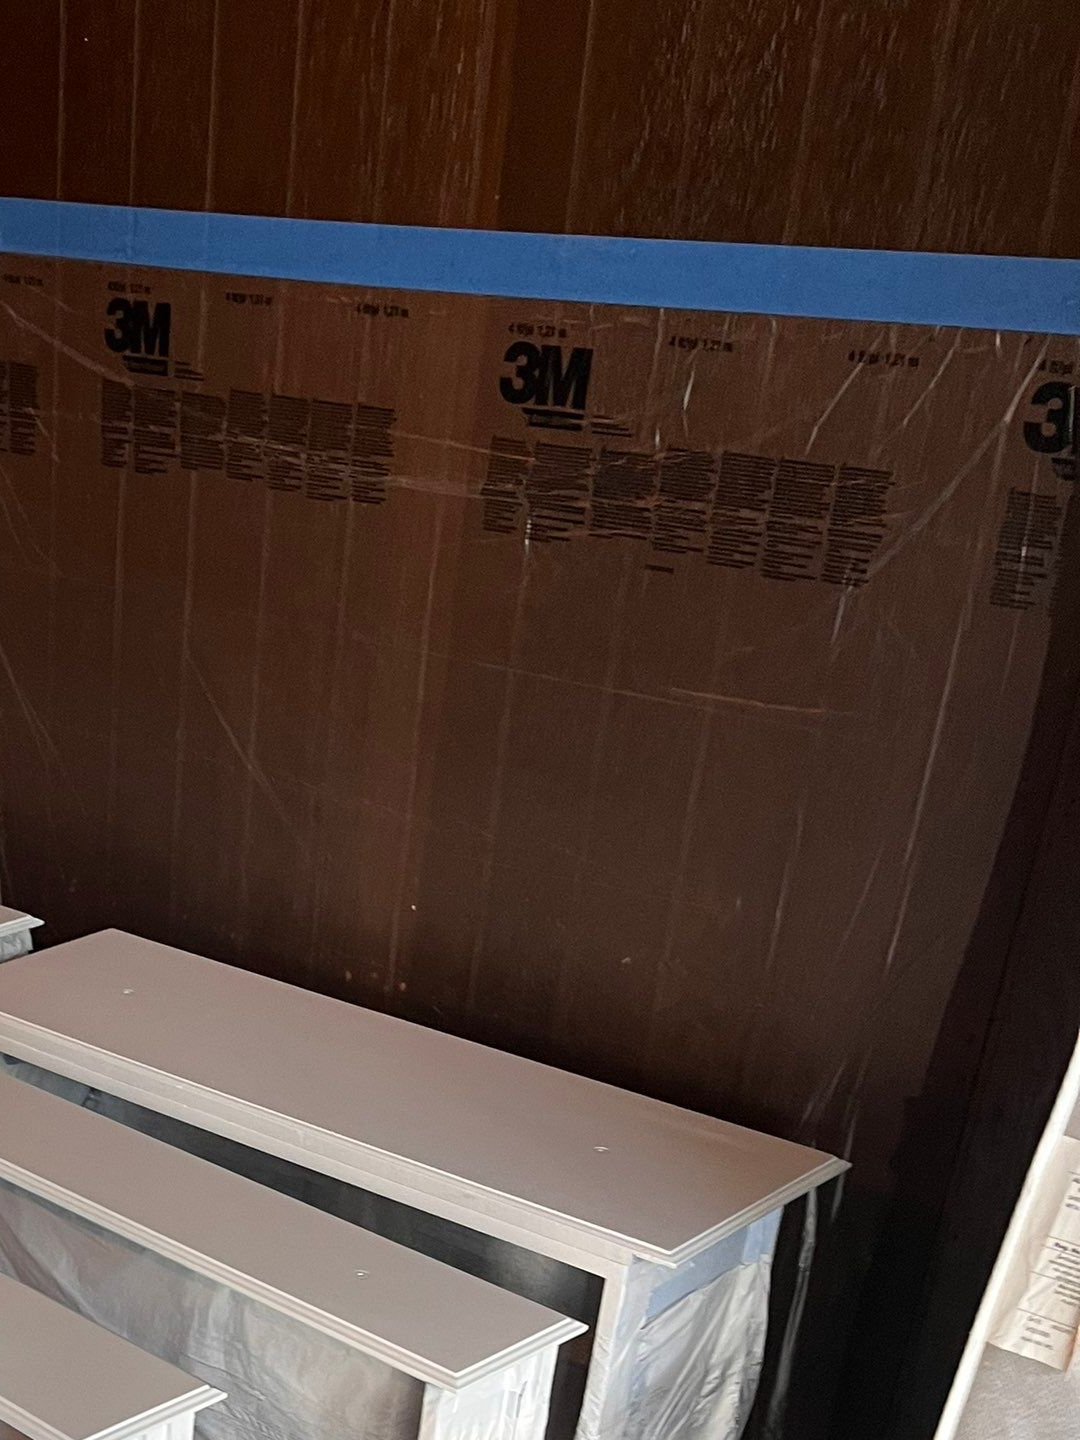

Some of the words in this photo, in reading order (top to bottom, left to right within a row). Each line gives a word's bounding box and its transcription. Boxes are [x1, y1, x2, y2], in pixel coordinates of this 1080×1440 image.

[104, 297, 171, 357] 3M
[499, 340, 594, 410] 3M
[1023, 381, 1080, 461] 3
